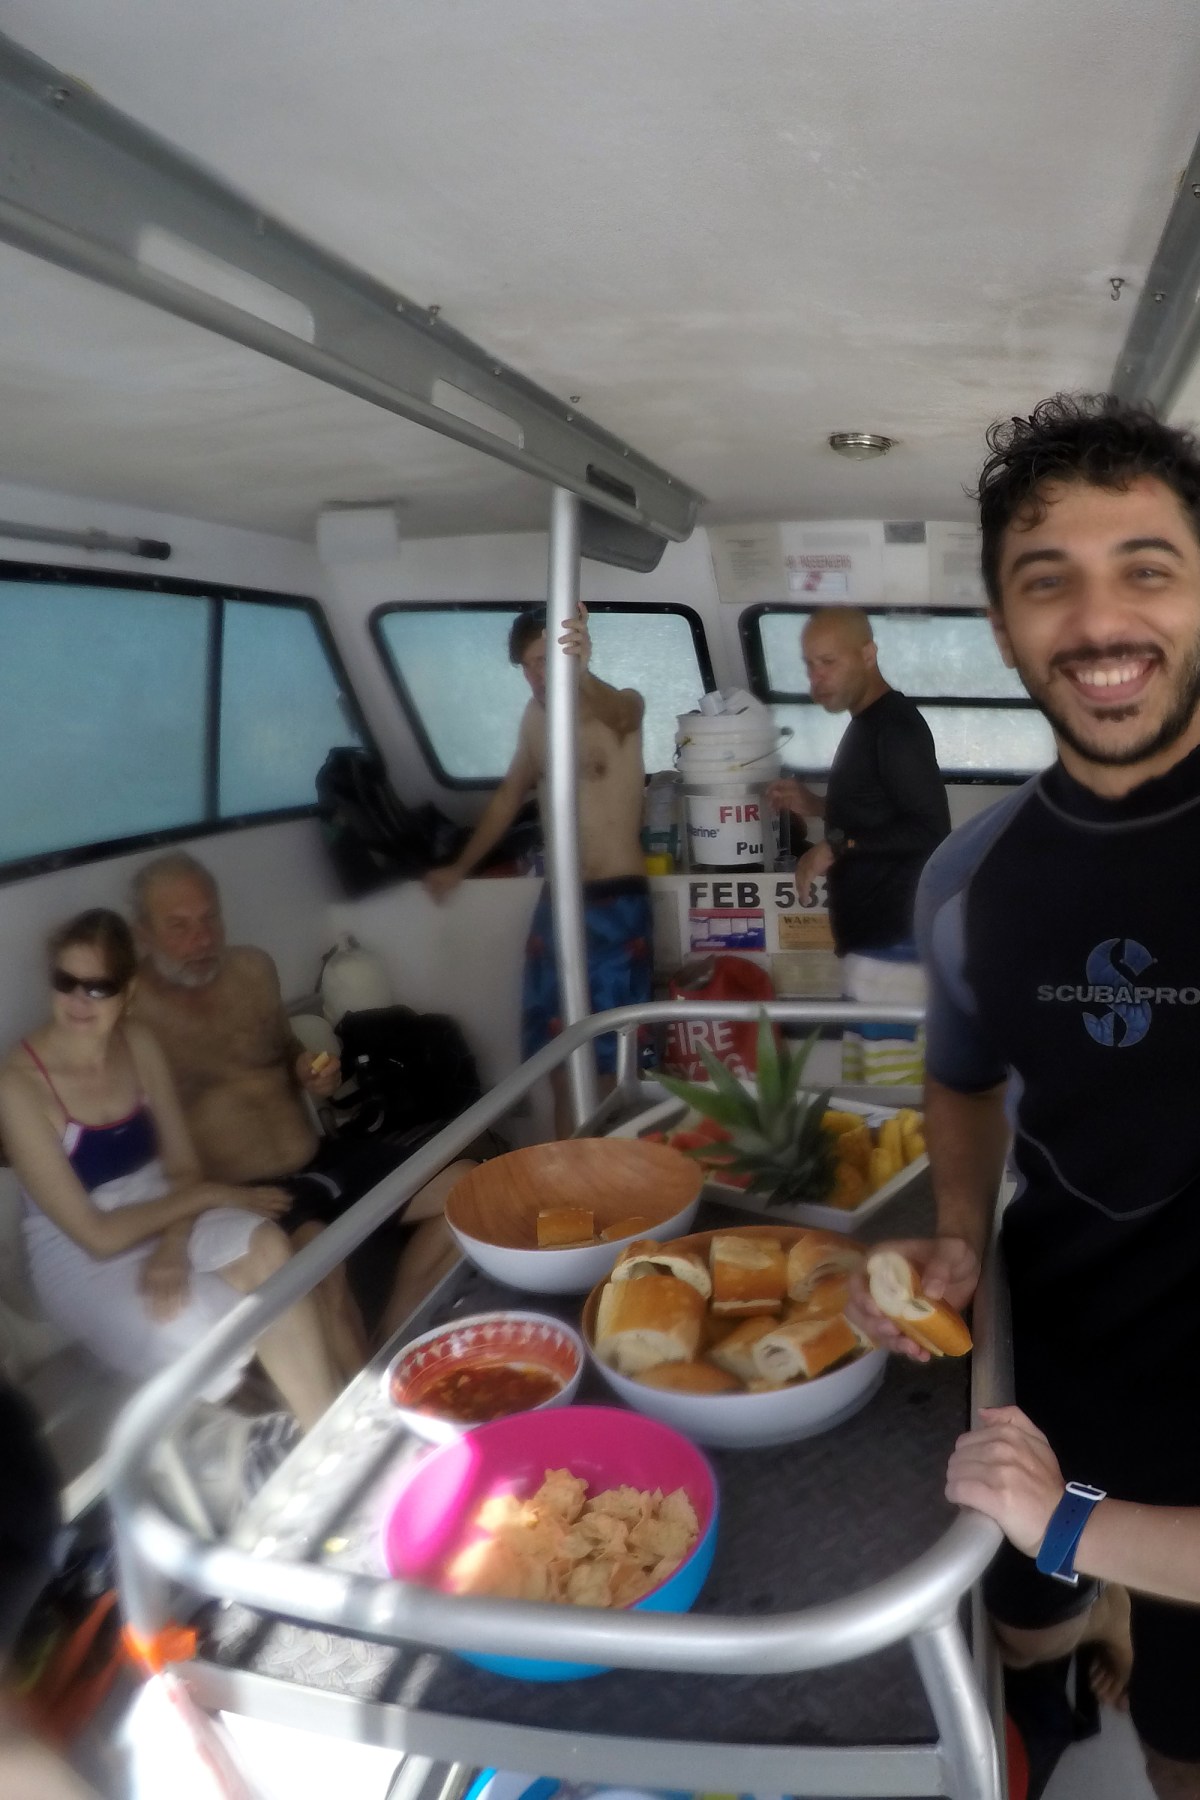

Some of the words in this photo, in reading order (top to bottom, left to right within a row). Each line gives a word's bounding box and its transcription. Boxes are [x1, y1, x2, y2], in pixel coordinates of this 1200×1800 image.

[719, 804, 760, 824] FIR
[736, 841, 764, 856] Pu
[688, 882, 761, 908] FEB
